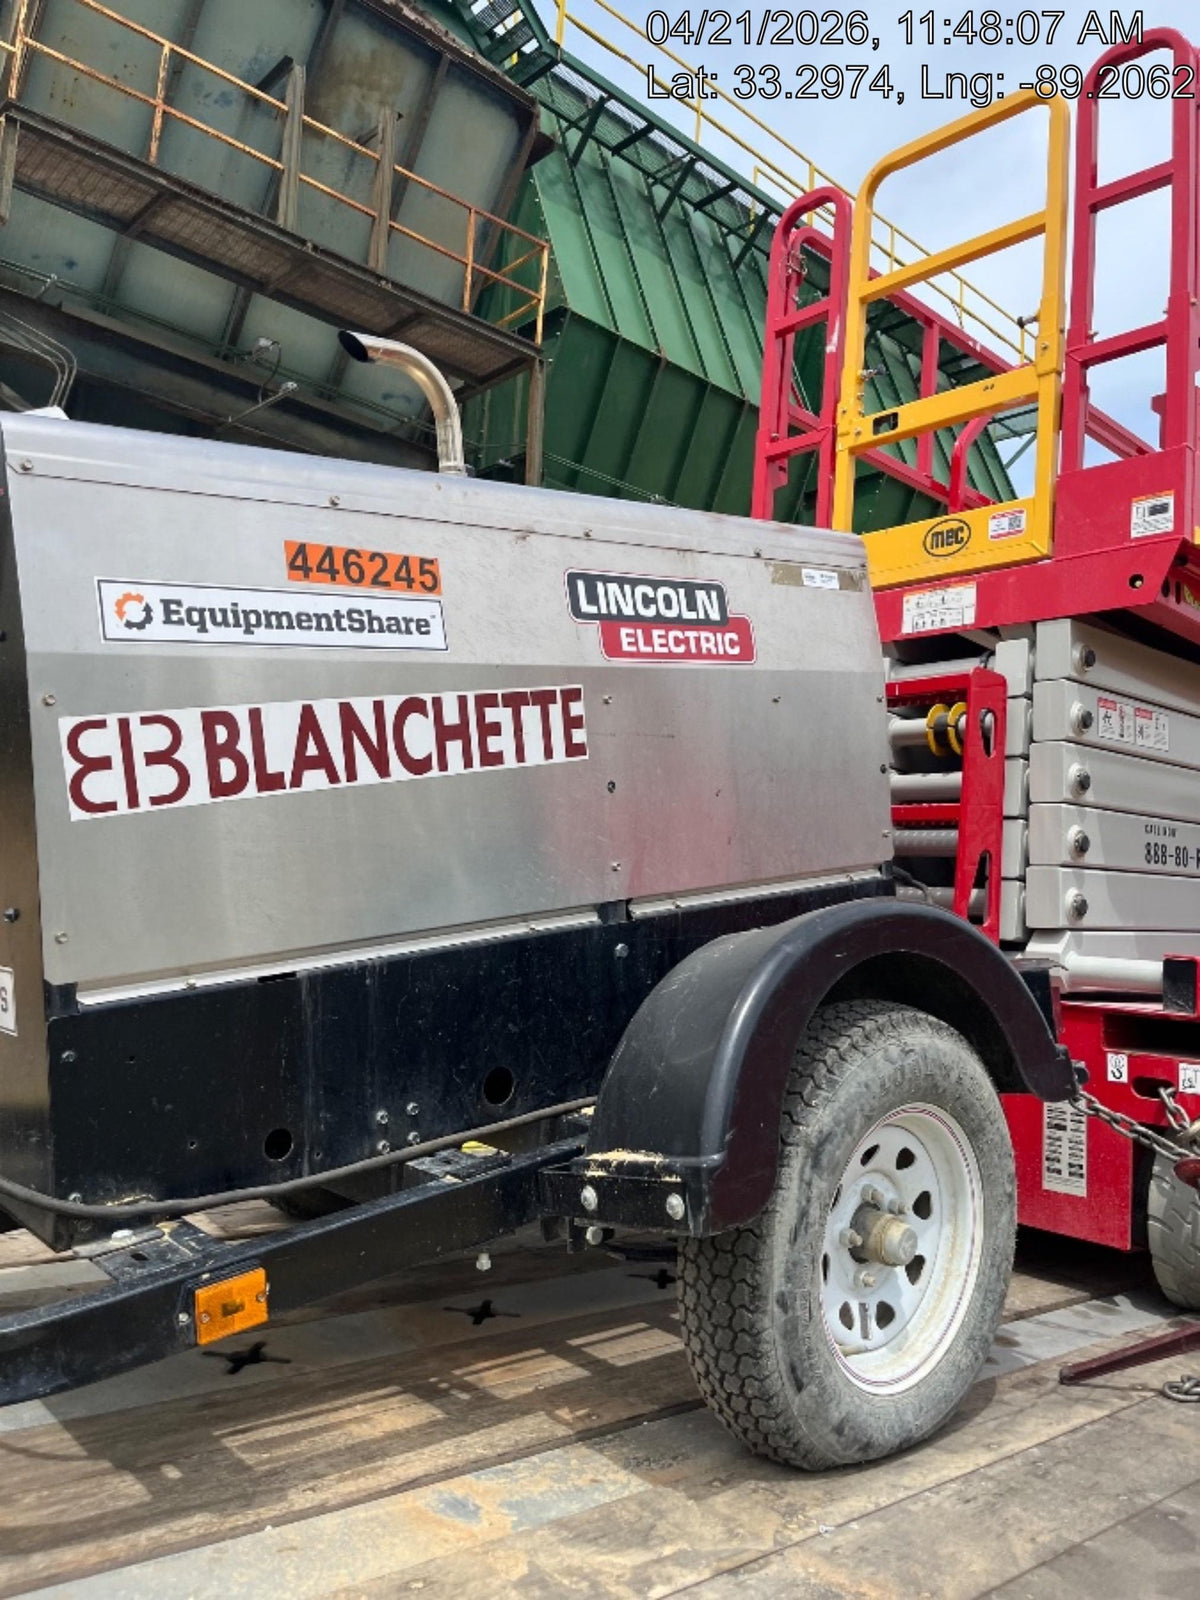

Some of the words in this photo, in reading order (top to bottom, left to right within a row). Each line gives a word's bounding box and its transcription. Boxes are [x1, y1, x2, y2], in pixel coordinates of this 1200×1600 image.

[288, 542, 439, 594] 446245
[159, 598, 432, 635] EquipmentShare
[576, 578, 721, 622] LINCOLN
[619, 626, 741, 656] ELECTRIC
[200, 687, 588, 800] BLANCHETTE
